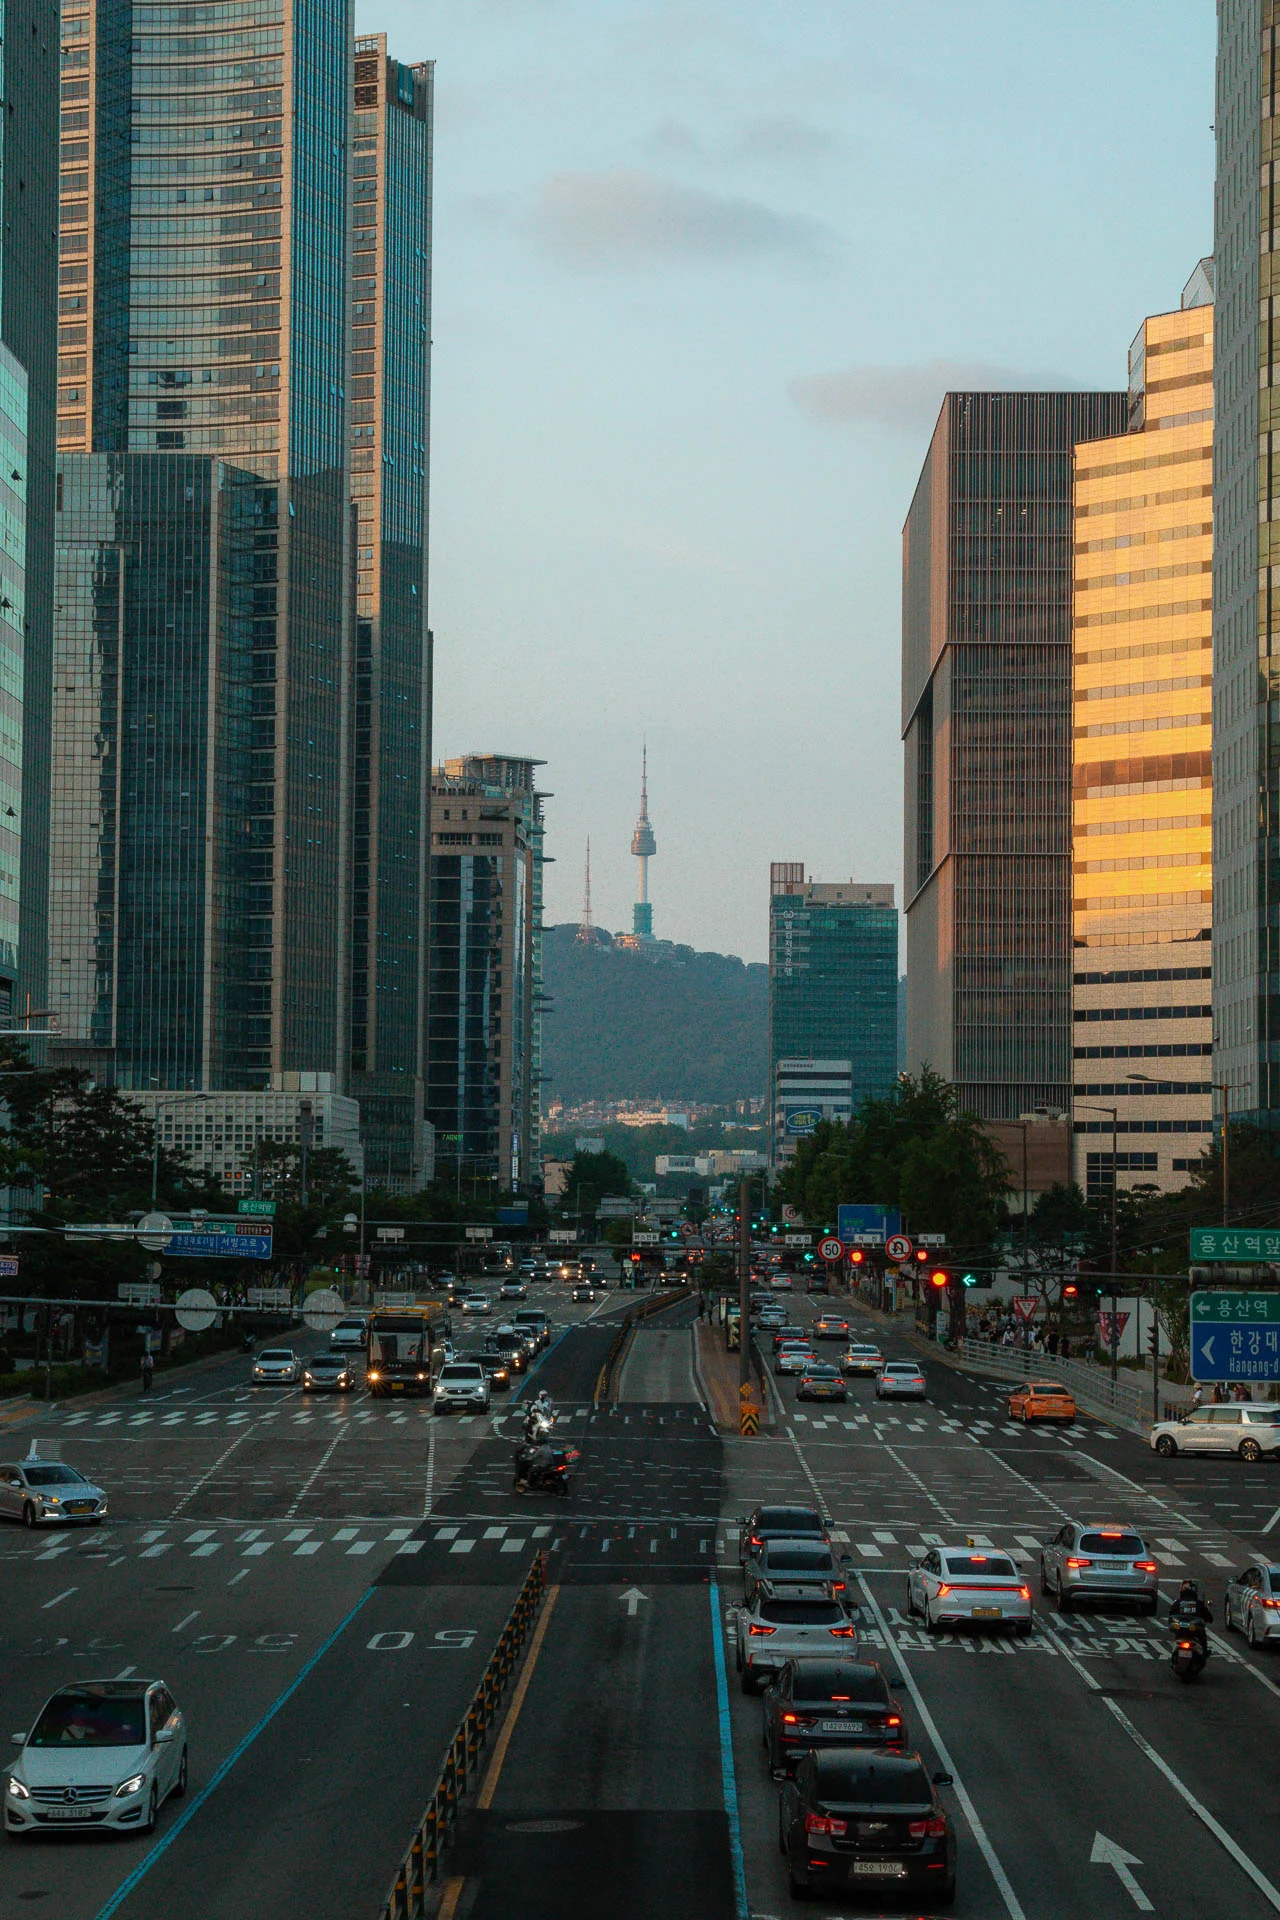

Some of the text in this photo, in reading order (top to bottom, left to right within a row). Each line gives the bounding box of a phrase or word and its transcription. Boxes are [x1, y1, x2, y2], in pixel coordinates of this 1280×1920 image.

[241, 1202, 272, 1212] 용산역앞
[221, 1237, 257, 1248] 서빙고로
[634, 1233, 658, 1242] 버스전용
[825, 1244, 839, 1256] 50
[1199, 1234, 1280, 1255] 용산역앞
[1216, 1299, 1268, 1318] 용산역
